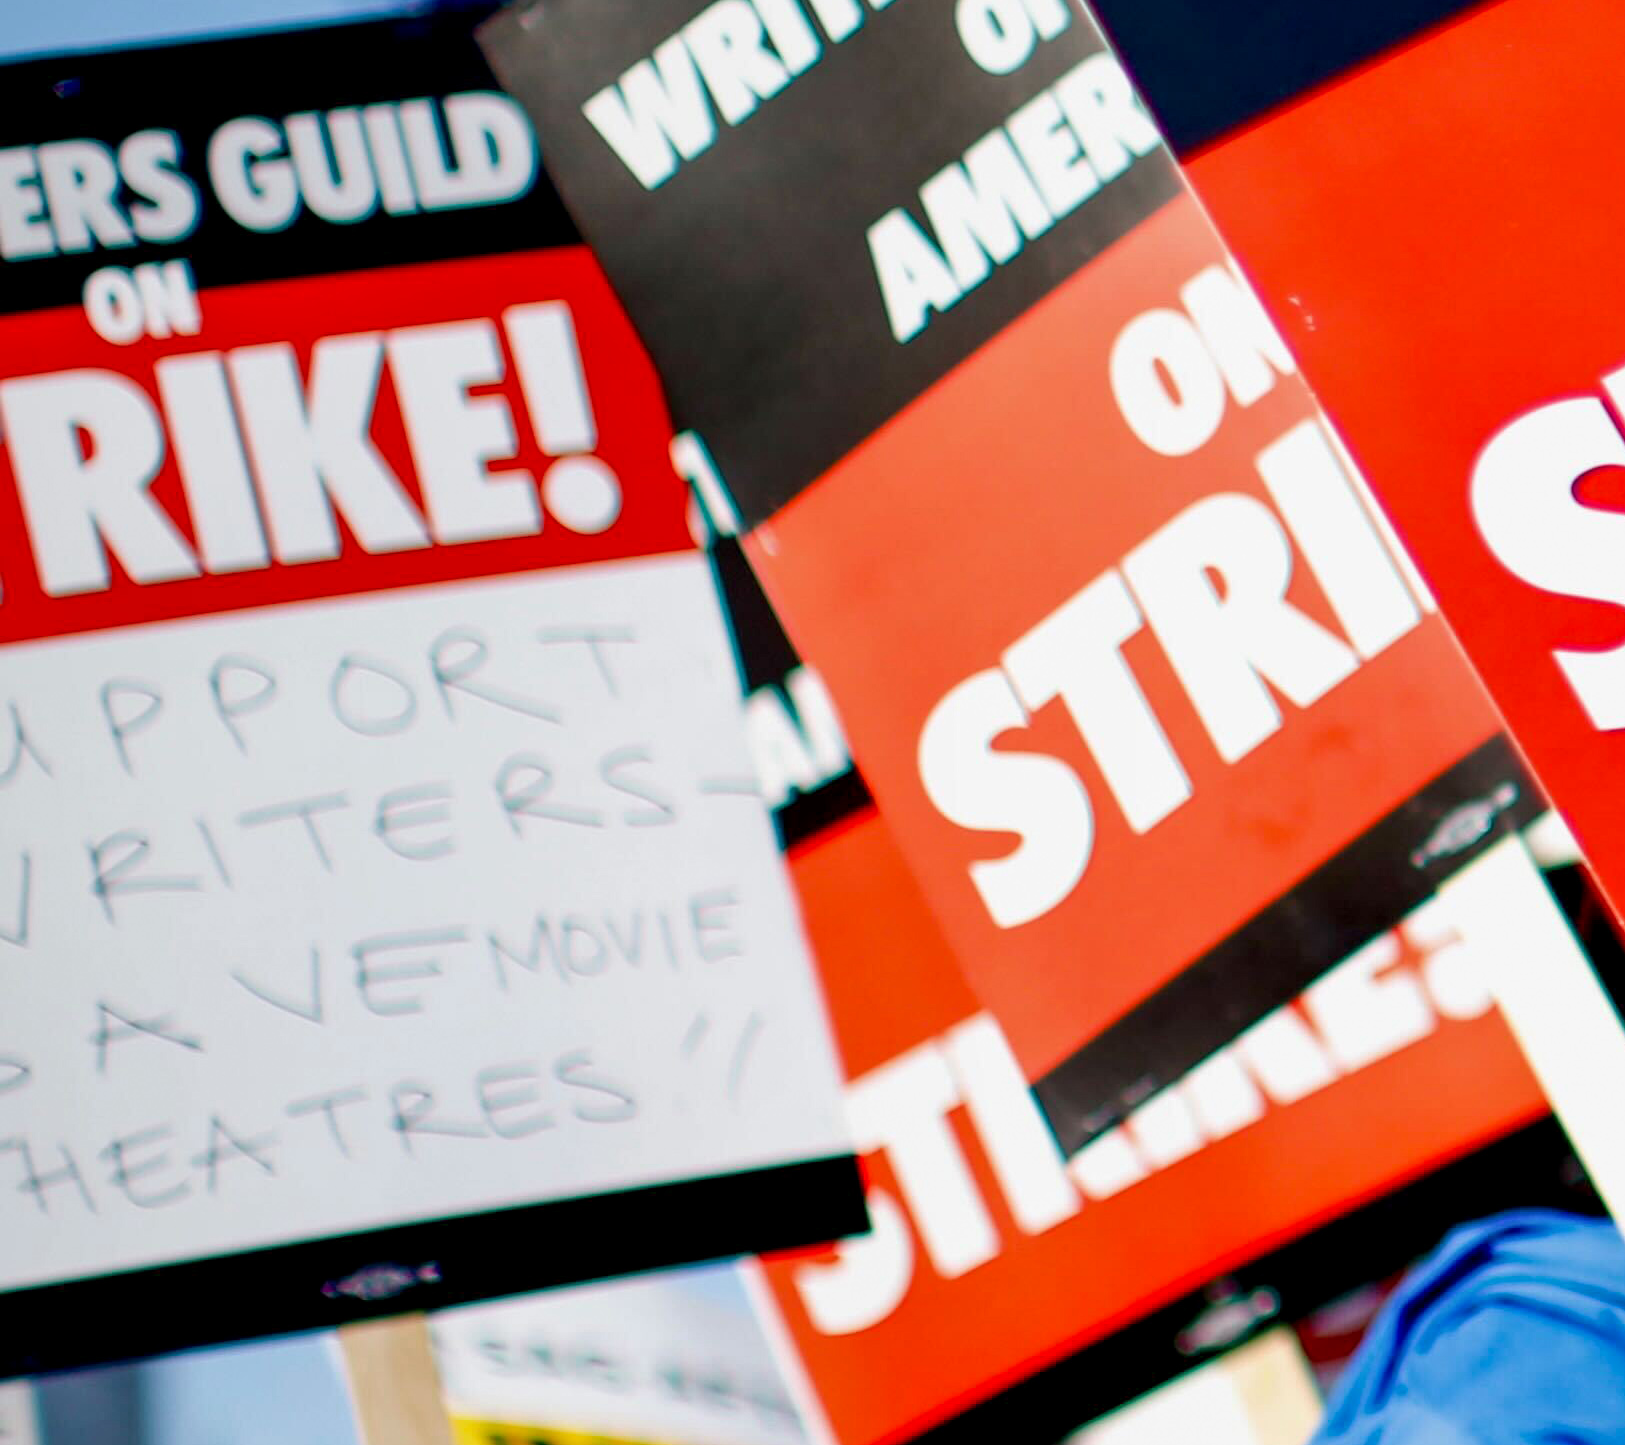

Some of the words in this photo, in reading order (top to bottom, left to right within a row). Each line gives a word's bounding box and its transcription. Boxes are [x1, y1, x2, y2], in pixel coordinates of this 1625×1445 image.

[209, 90, 538, 233] GUILD
[866, 52, 1164, 343] AMER
[83, 260, 201, 345] ON
[0, 300, 623, 598] RIKE!
[917, 417, 1437, 929] STRI
[486, 886, 742, 991] MOVIE
